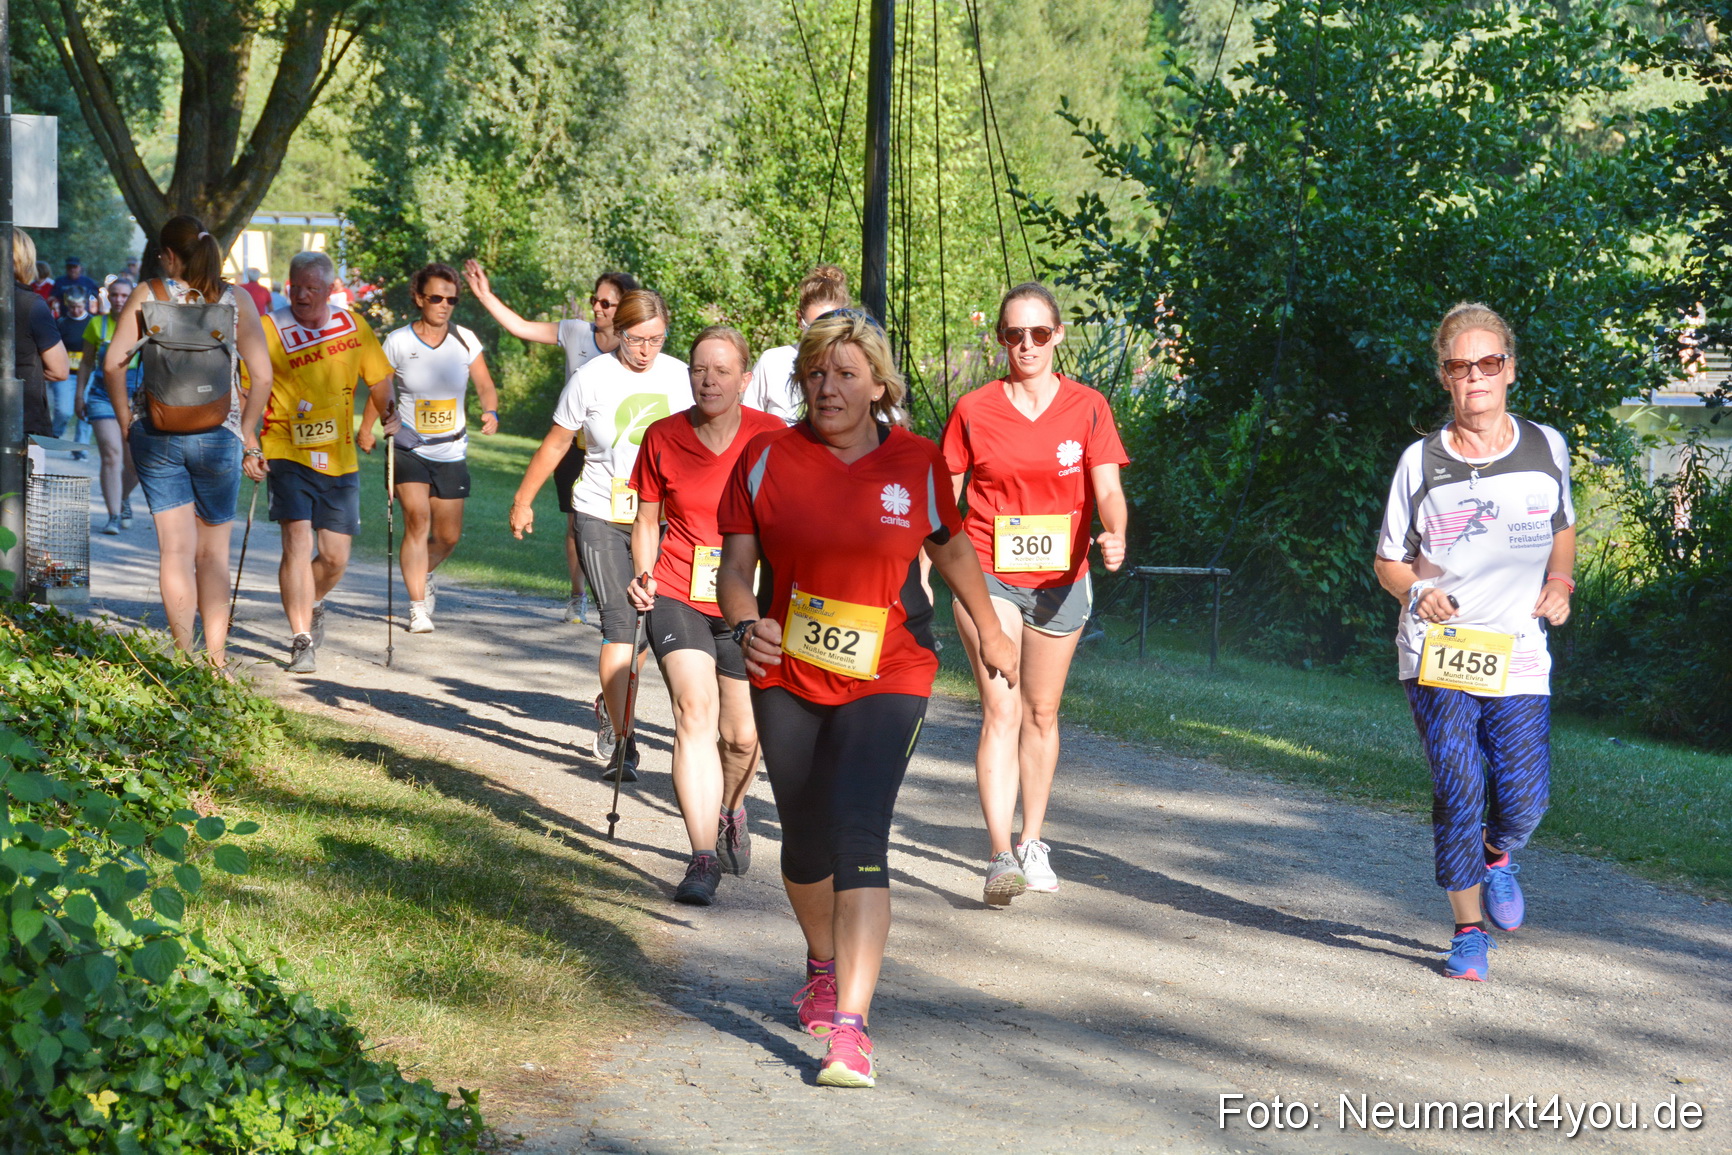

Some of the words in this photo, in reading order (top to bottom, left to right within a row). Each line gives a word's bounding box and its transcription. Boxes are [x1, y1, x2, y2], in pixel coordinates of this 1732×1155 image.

[288, 350, 324, 369] MAX
[326, 337, 362, 356] BÖGL
[421, 410, 452, 424] 1554
[296, 420, 334, 438] 1225
[1058, 466, 1081, 477] caritas
[880, 516, 911, 528] caritas
[1507, 519, 1549, 532] VORSICHT
[1012, 535, 1052, 555] 360
[804, 621, 860, 656] 362
[803, 643, 827, 657] Nüßler
[827, 652, 855, 665] Mireille
[1434, 647, 1498, 676] 1458
[1443, 671, 1464, 680] Mundt
[1465, 674, 1484, 682] Elvira
